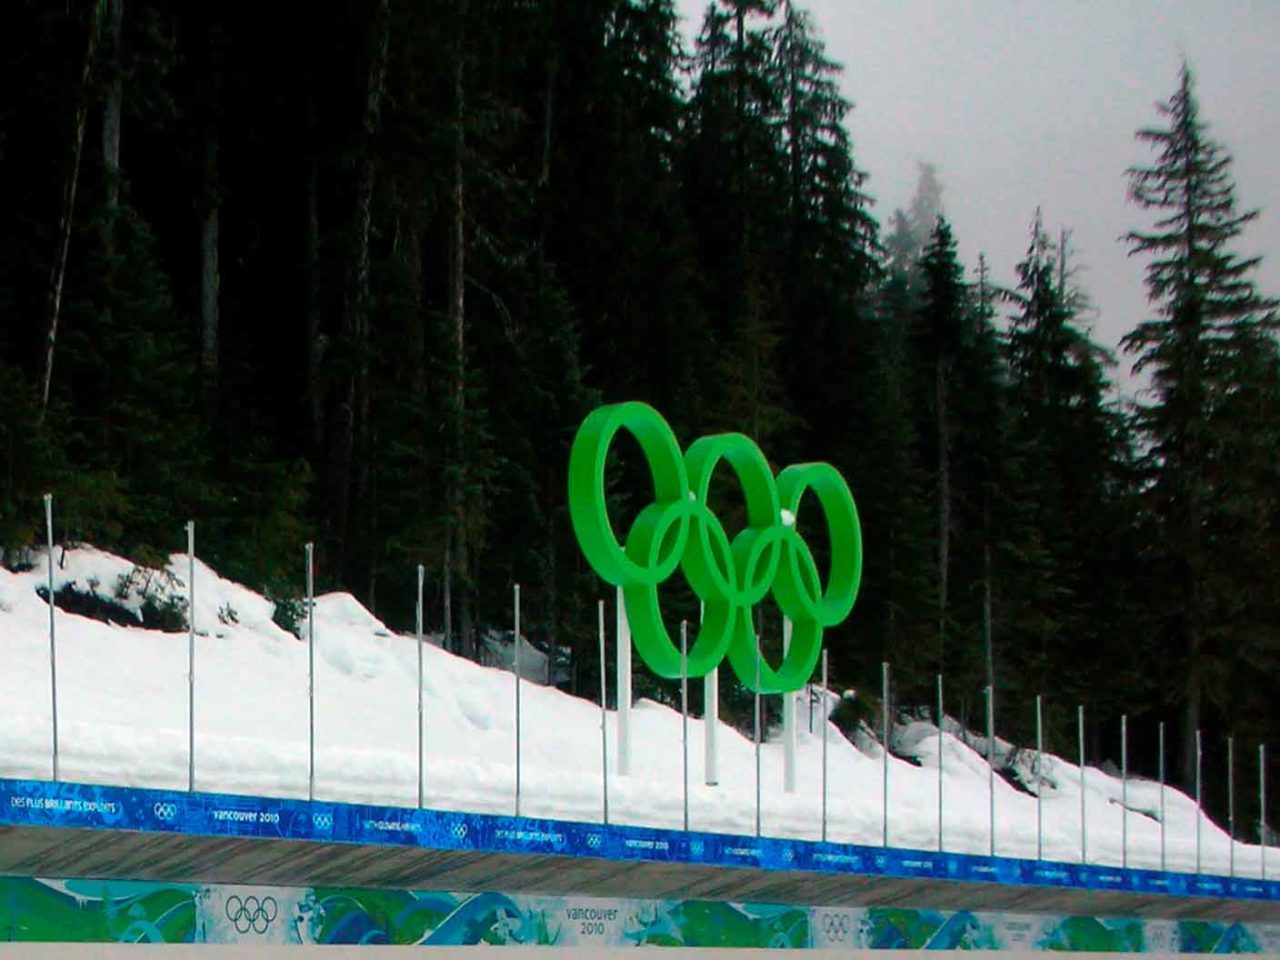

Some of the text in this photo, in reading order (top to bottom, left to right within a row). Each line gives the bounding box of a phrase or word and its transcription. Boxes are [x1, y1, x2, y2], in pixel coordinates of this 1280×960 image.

[213, 810, 280, 824] vancouver 2010
[566, 908, 618, 921] vancouver
[581, 922, 605, 936] 2010
